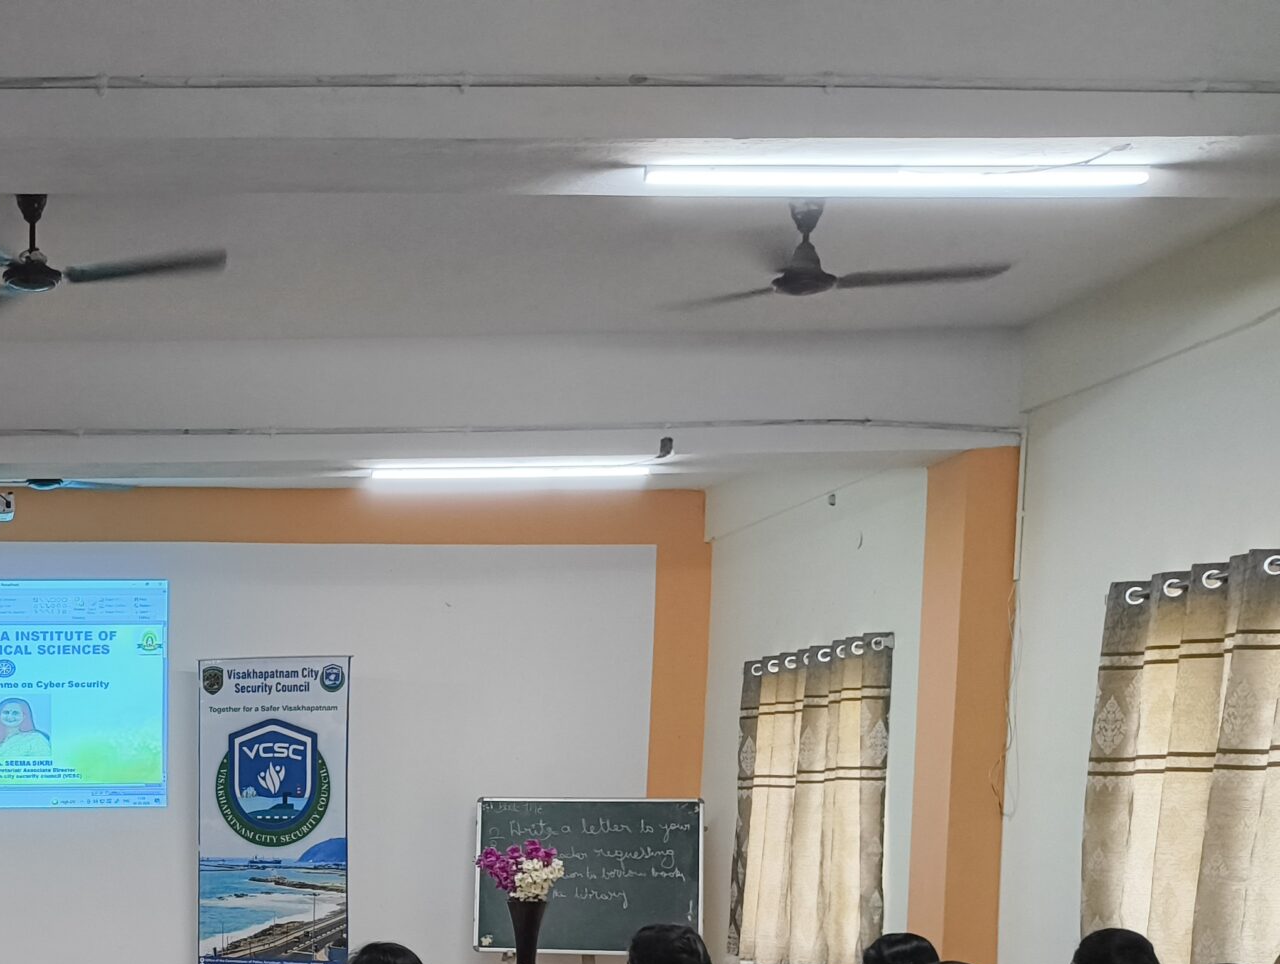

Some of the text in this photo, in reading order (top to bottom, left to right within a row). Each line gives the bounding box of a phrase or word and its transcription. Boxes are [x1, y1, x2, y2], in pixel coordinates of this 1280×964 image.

[15, 630, 93, 642] INSTITUTE
[98, 630, 118, 641] OF
[37, 644, 110, 655] SCIENCES
[227, 668, 320, 681] Visakhapatnam City
[36, 680, 65, 690] Cyber
[68, 680, 110, 690] Security
[234, 682, 310, 695] Security Council
[209, 706, 240, 714] Together
[242, 742, 304, 760] VCSC
[217, 766, 330, 844] VISAKHAPATNAM CITY SECURITY COUNCIL
[582, 818, 632, 834] letter
[659, 822, 690, 843] your
[594, 847, 674, 868] requesting
[602, 866, 646, 880] borrow
[575, 887, 628, 909] library
